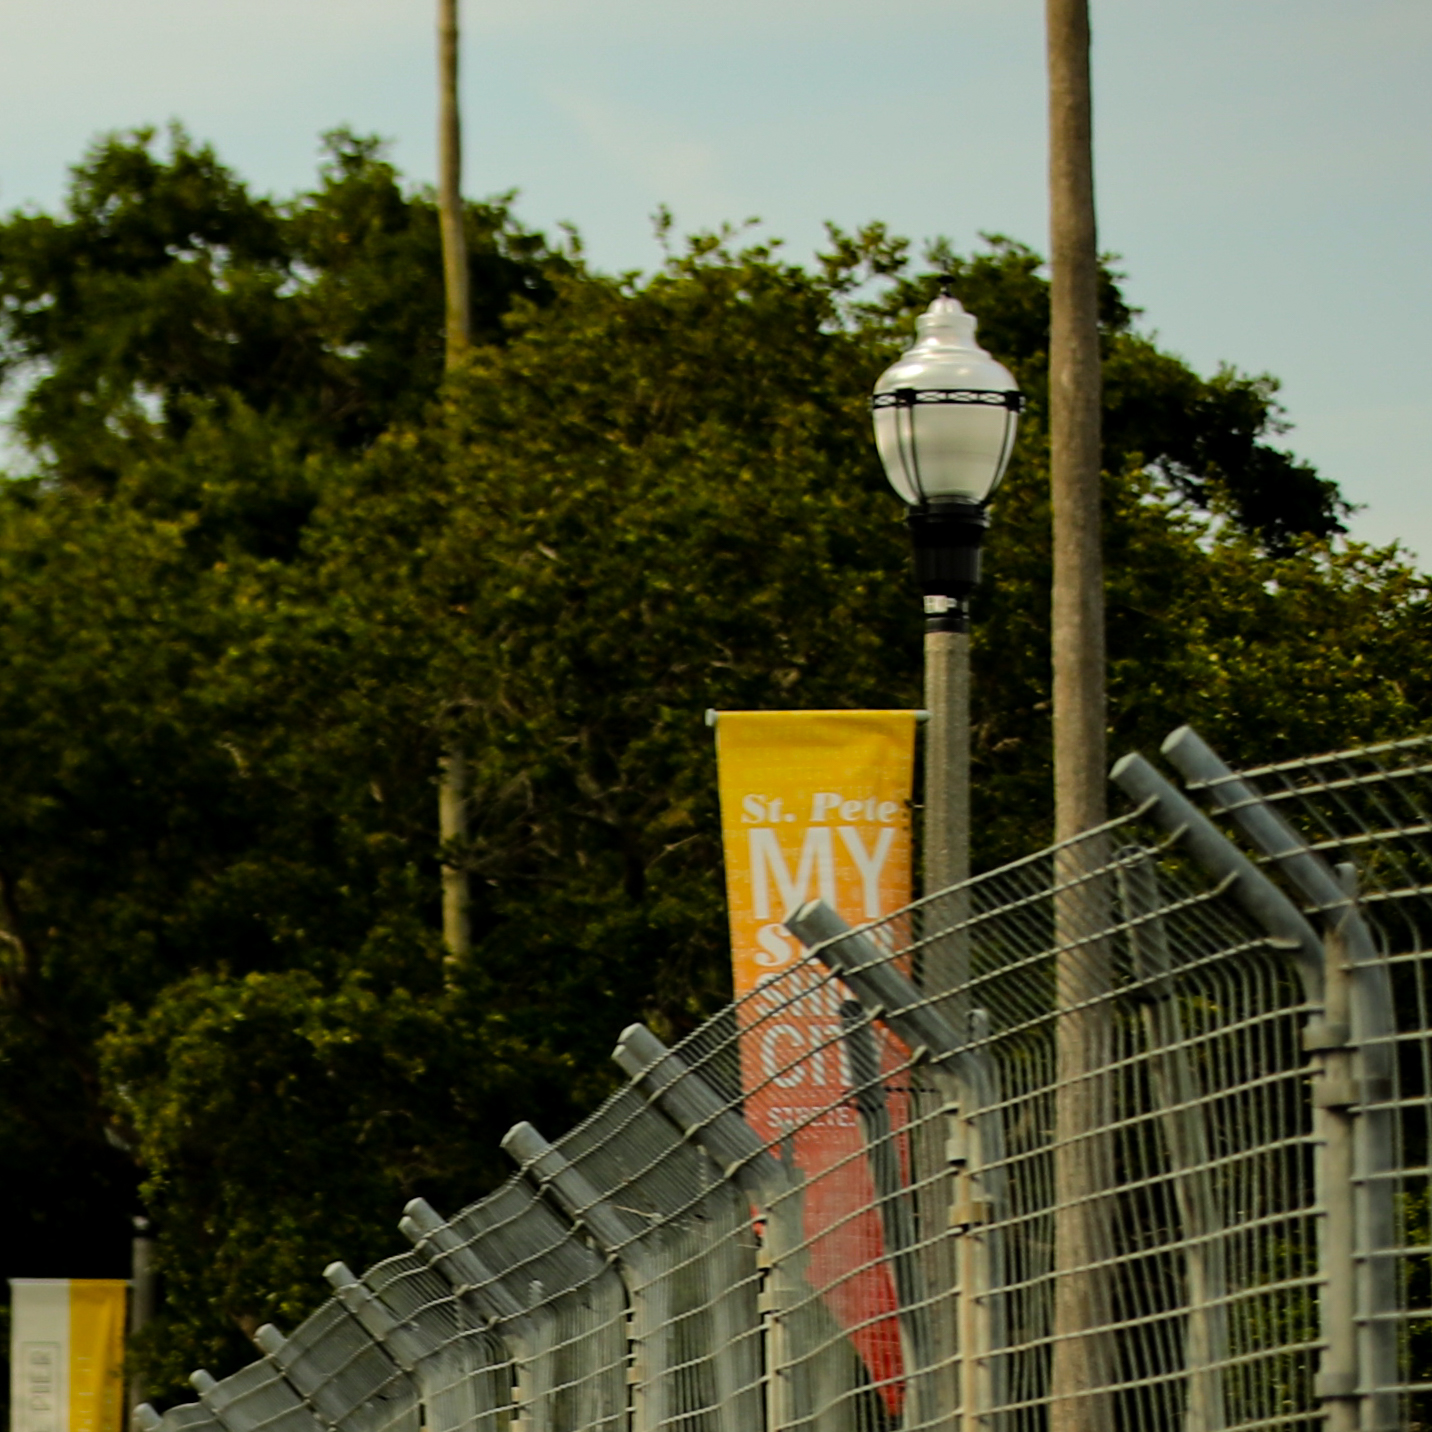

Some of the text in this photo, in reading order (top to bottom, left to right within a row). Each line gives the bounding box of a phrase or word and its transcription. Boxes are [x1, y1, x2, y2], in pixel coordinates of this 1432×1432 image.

[740, 792, 900, 824] St. Pete
[747, 826, 896, 920] MY
